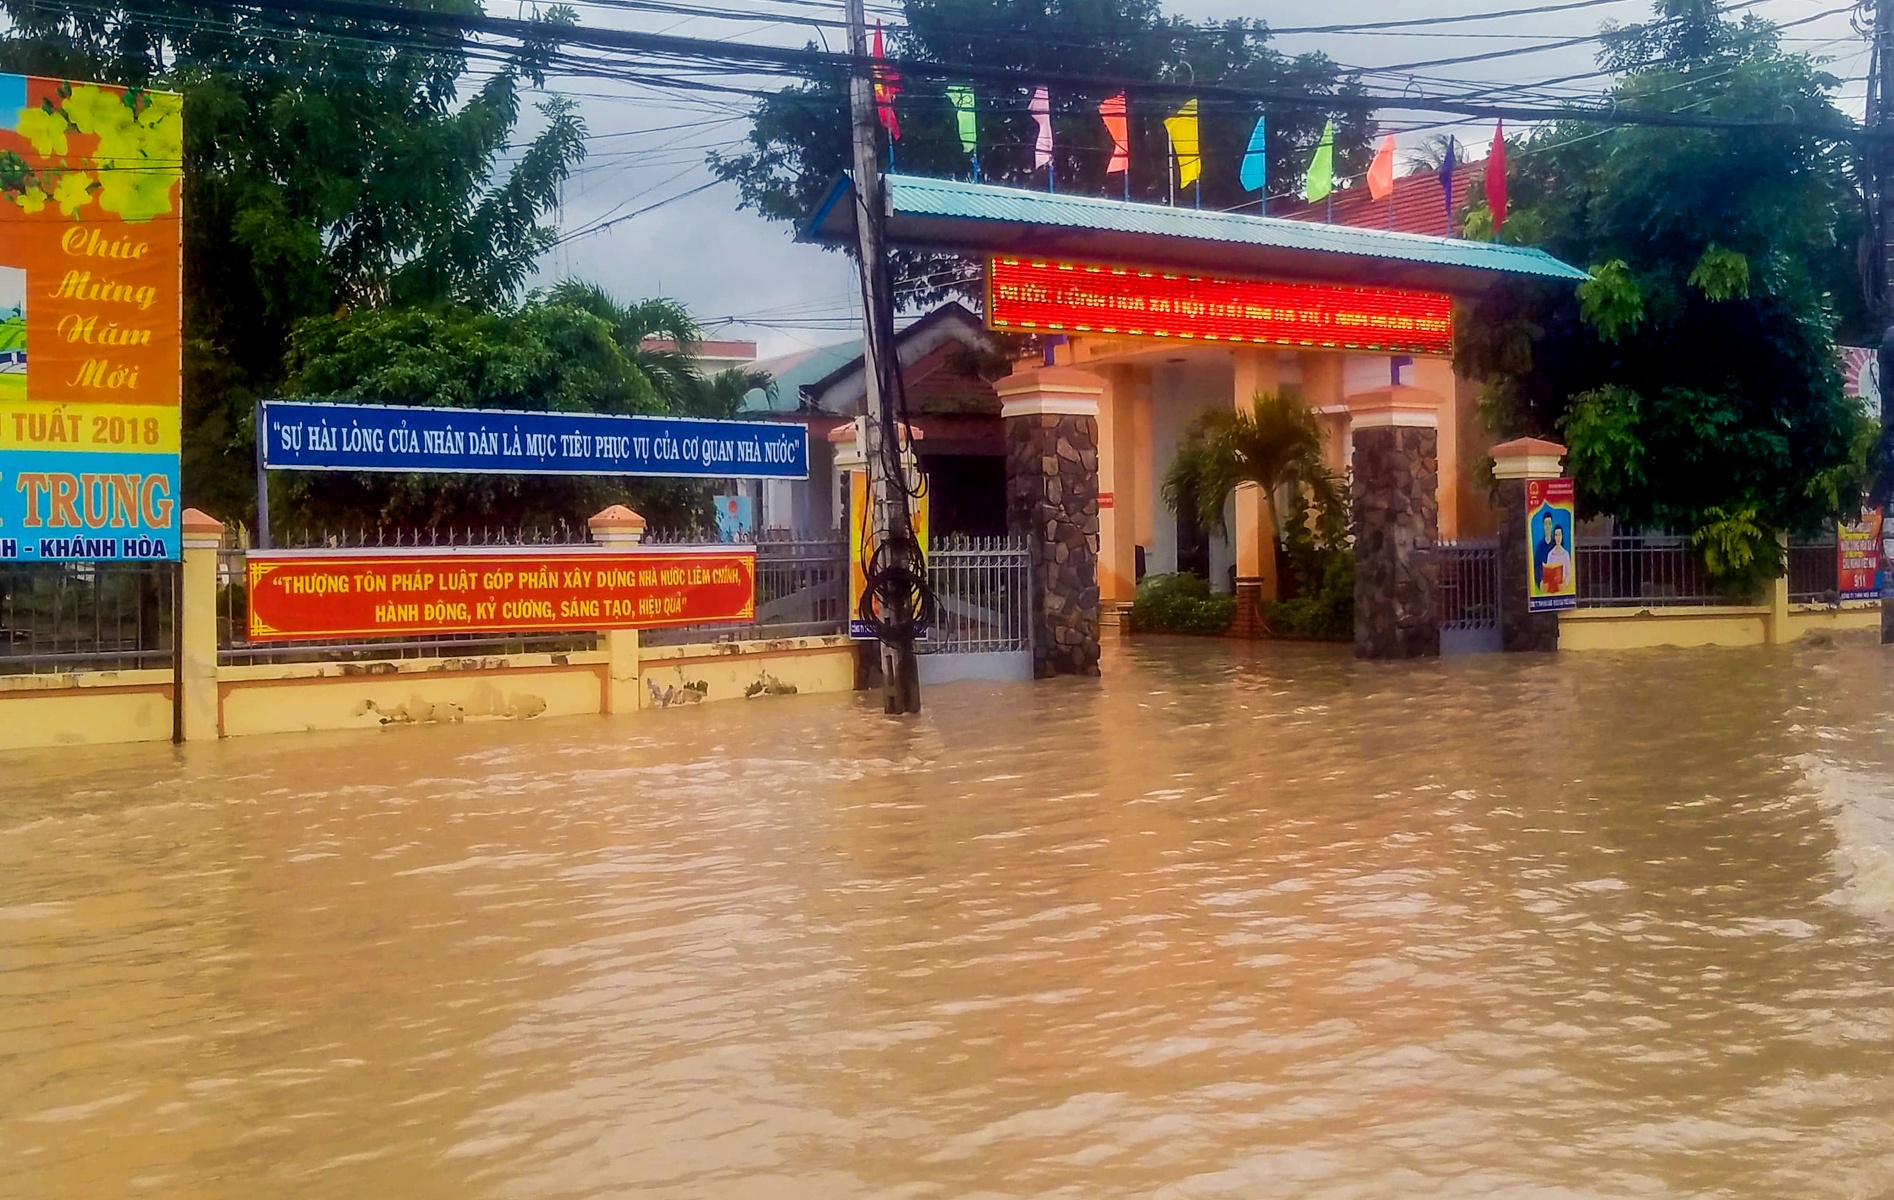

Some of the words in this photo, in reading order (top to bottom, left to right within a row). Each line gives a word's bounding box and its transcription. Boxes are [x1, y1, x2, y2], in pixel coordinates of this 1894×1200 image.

[61, 226, 149, 259] Chúc
[48, 270, 158, 311] Mừng
[56, 314, 152, 347] Năm
[65, 358, 140, 390] Mới
[12, 404, 82, 443] TUẤT
[91, 416, 160, 446] 2018
[308, 418, 338, 452] HÀI
[342, 419, 384, 453] LÒNG
[388, 420, 420, 454] CỦA
[424, 425, 465, 456] NHÂN
[469, 425, 499, 456] DÂN
[503, 425, 523, 457] LÀ
[526, 433, 557, 463] MỤC
[560, 430, 592, 458] TIÊU
[595, 435, 630, 464] PHỤC
[633, 437, 650, 464] VỤ
[653, 430, 680, 461] CỦA
[682, 439, 700, 462] CƠ
[701, 440, 735, 467] QUAN
[737, 436, 762, 463] NHÀ
[16, 472, 174, 529] TRUNG
[40, 534, 116, 559] KHÁNH
[123, 534, 168, 559] HÒA
[354, 570, 387, 593] TÔN
[391, 569, 435, 593] PHÁP
[439, 568, 478, 594] LUẬT
[483, 568, 515, 590] GÓP
[518, 564, 559, 589] PHẦN
[563, 567, 592, 588] XÂY
[596, 568, 636, 591] DỰNG
[638, 568, 658, 588] NHÀ
[660, 565, 686, 587] NƯỚC
[687, 564, 711, 586] LIÊM
[375, 600, 419, 623] HÀNH
[424, 599, 472, 624] ĐỘNG,
[476, 596, 497, 620] KỶ
[502, 598, 556, 621] CƯƠNG,
[560, 597, 600, 618] SÁNG
[603, 599, 636, 620] TẠO,
[639, 594, 662, 616] HIỆU
